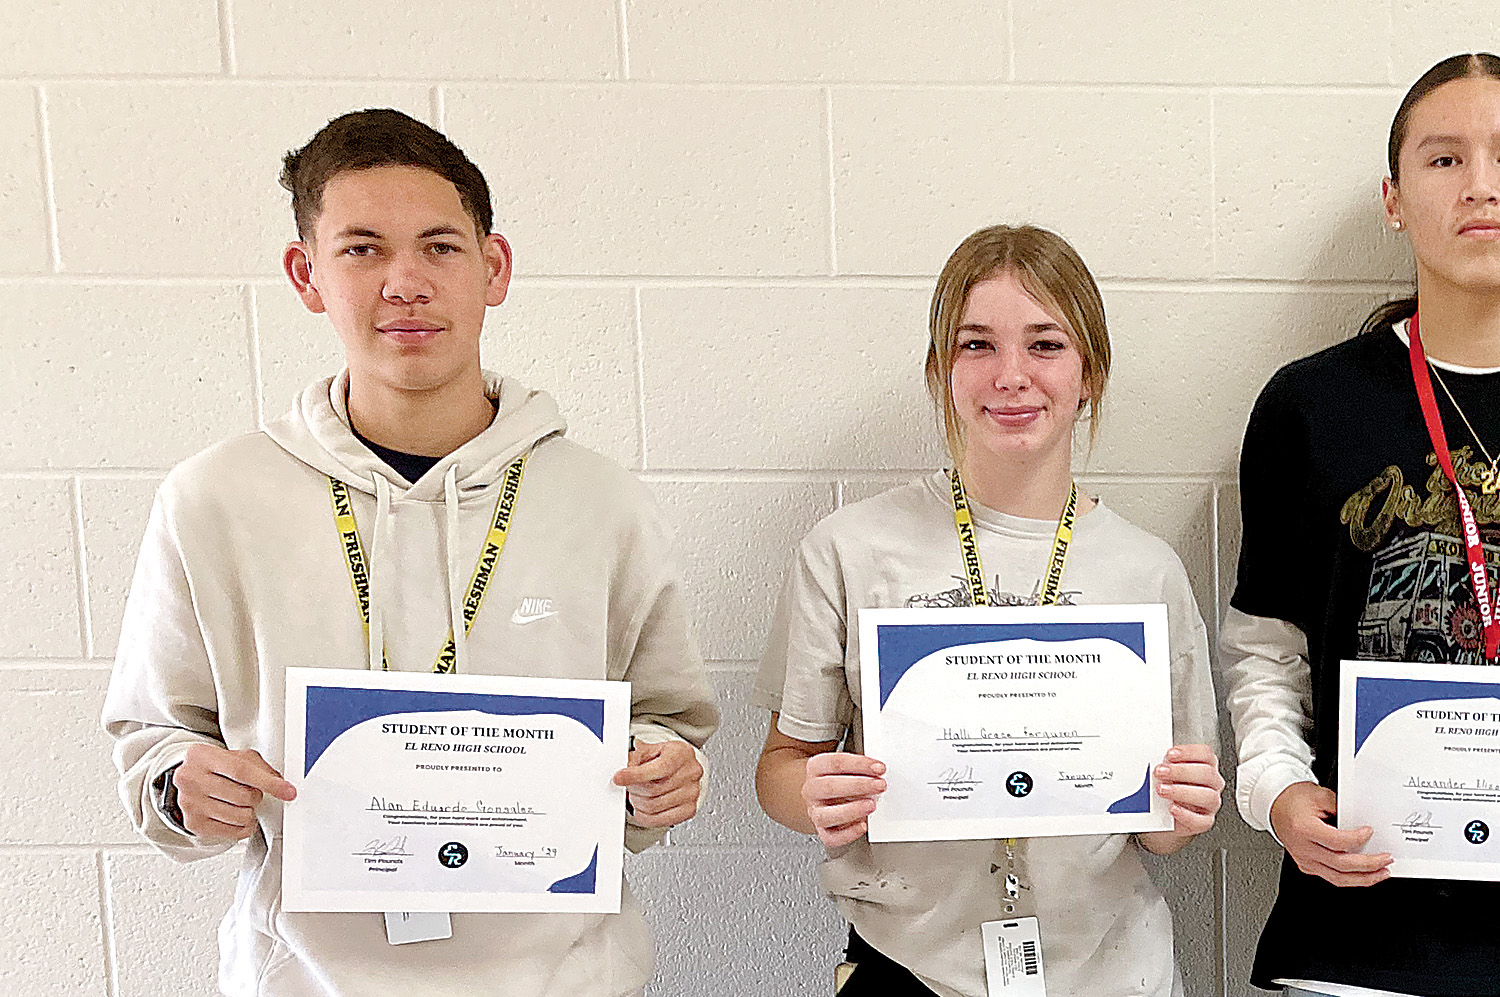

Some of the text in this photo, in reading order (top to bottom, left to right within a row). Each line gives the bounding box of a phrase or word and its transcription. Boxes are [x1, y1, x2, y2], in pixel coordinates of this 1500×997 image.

[494, 459, 523, 532] FRESHMA
[959, 523, 986, 605] FRESHMAN
[1042, 538, 1068, 605] FRESHMA
[1472, 562, 1493, 627] JUNIOR
[520, 597, 552, 615] NIKE
[945, 654, 1101, 665] STUDENT OF THE MONTH
[967, 671, 1078, 680] EL RENO HIGH SCHOOL
[1416, 710, 1470, 721] STUDENT
[1472, 712, 1488, 722] OF
[382, 723, 555, 739] STUDENT OF THE MONTH
[1435, 726, 1446, 734] EL
[1448, 727, 1473, 735] RENO
[1474, 728, 1499, 737] HIGH
[404, 742, 527, 754] EL RENO HIGH SCHOOL
[1408, 776, 1466, 790] Alexander
[370, 796, 403, 811] Alan
